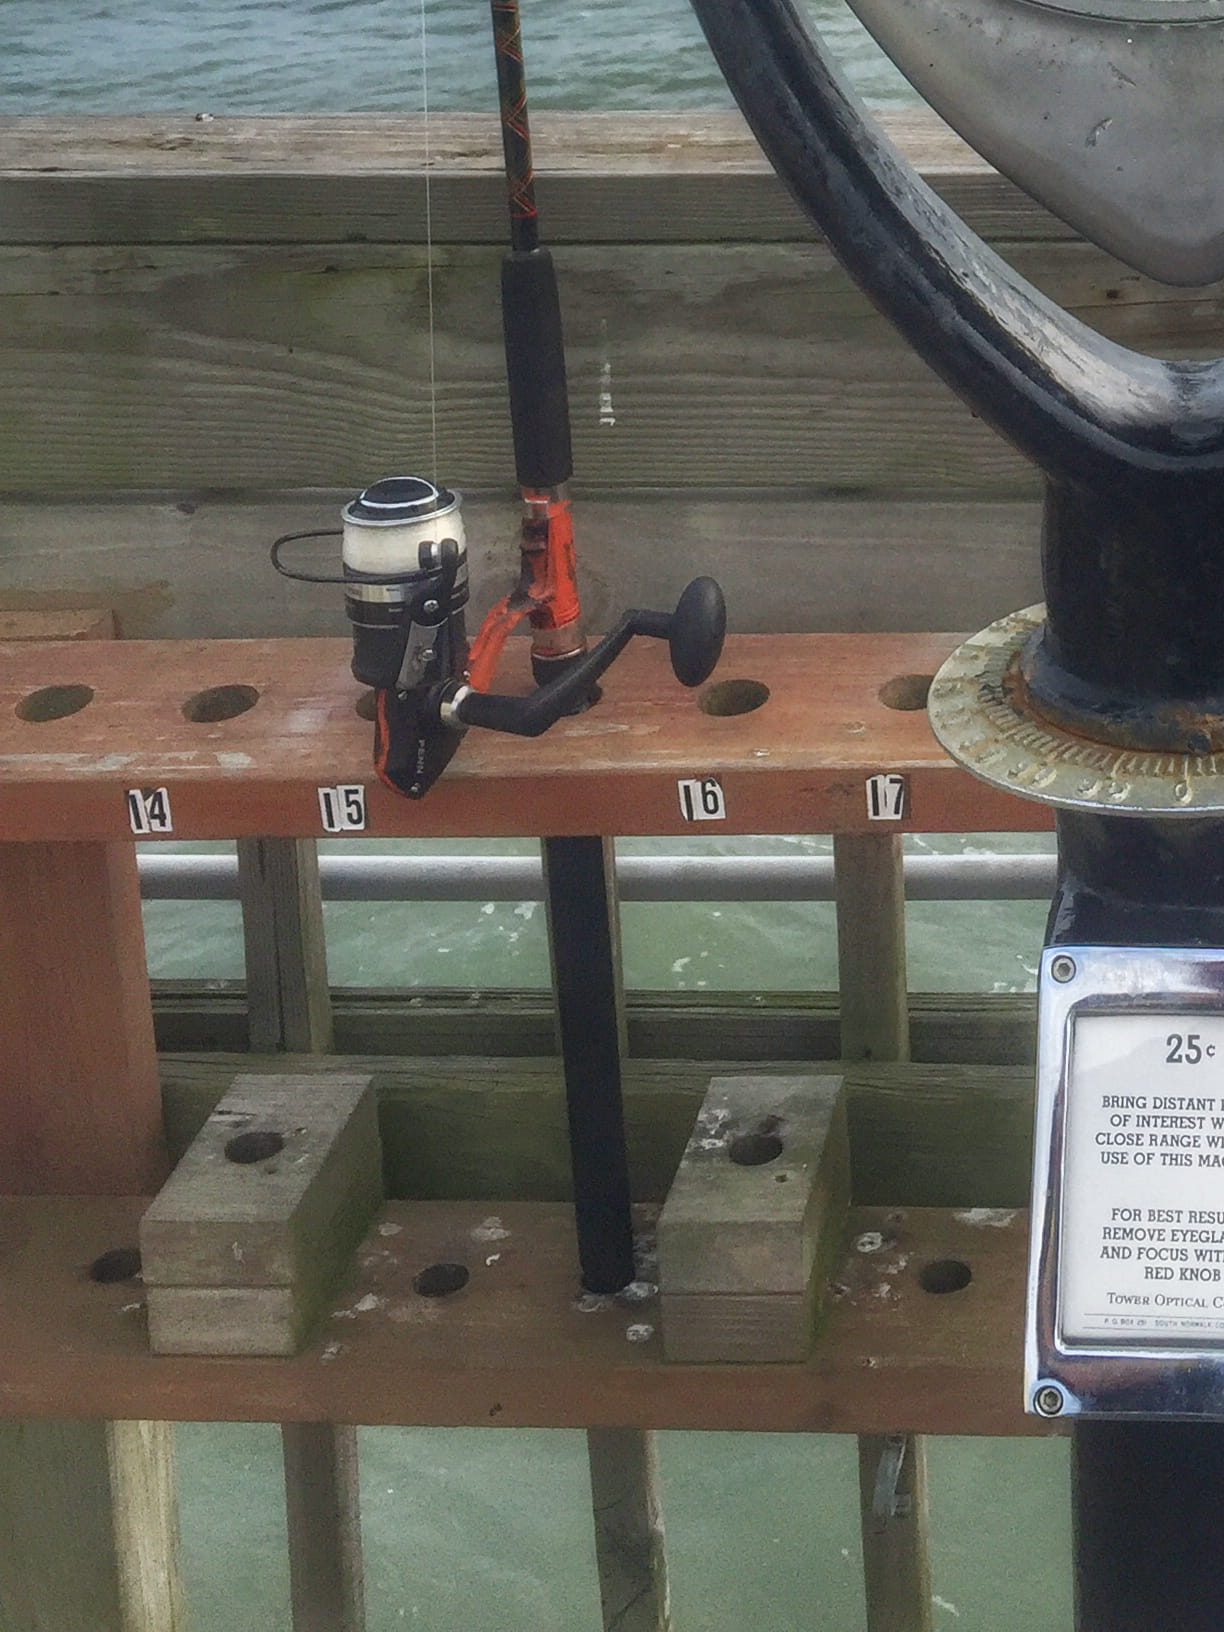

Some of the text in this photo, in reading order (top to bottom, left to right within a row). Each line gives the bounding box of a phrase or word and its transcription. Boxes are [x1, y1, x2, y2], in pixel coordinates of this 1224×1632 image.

[683, 778, 720, 820] 16
[129, 790, 167, 830] 14
[322, 789, 362, 828] 15
[1102, 1096, 1147, 1109] BRING
[1152, 1097, 1216, 1111] DISTANT
[1110, 1114, 1131, 1127] OF
[1136, 1115, 1205, 1129] INTEREST
[1096, 1133, 1144, 1146] CLOSE
[1149, 1134, 1201, 1148] RANGE
[1101, 1152, 1128, 1165] USE
[1134, 1152, 1155, 1165] OF
[1160, 1153, 1192, 1166] THIS
[1111, 1208, 1141, 1222] FOR
[1147, 1209, 1183, 1224] BEST
[1102, 1227, 1165, 1241] REMOVE
[1100, 1246, 1131, 1259] AND
[1137, 1247, 1188, 1261] FOCUS
[1144, 1267, 1221, 1281] RED KNOB
